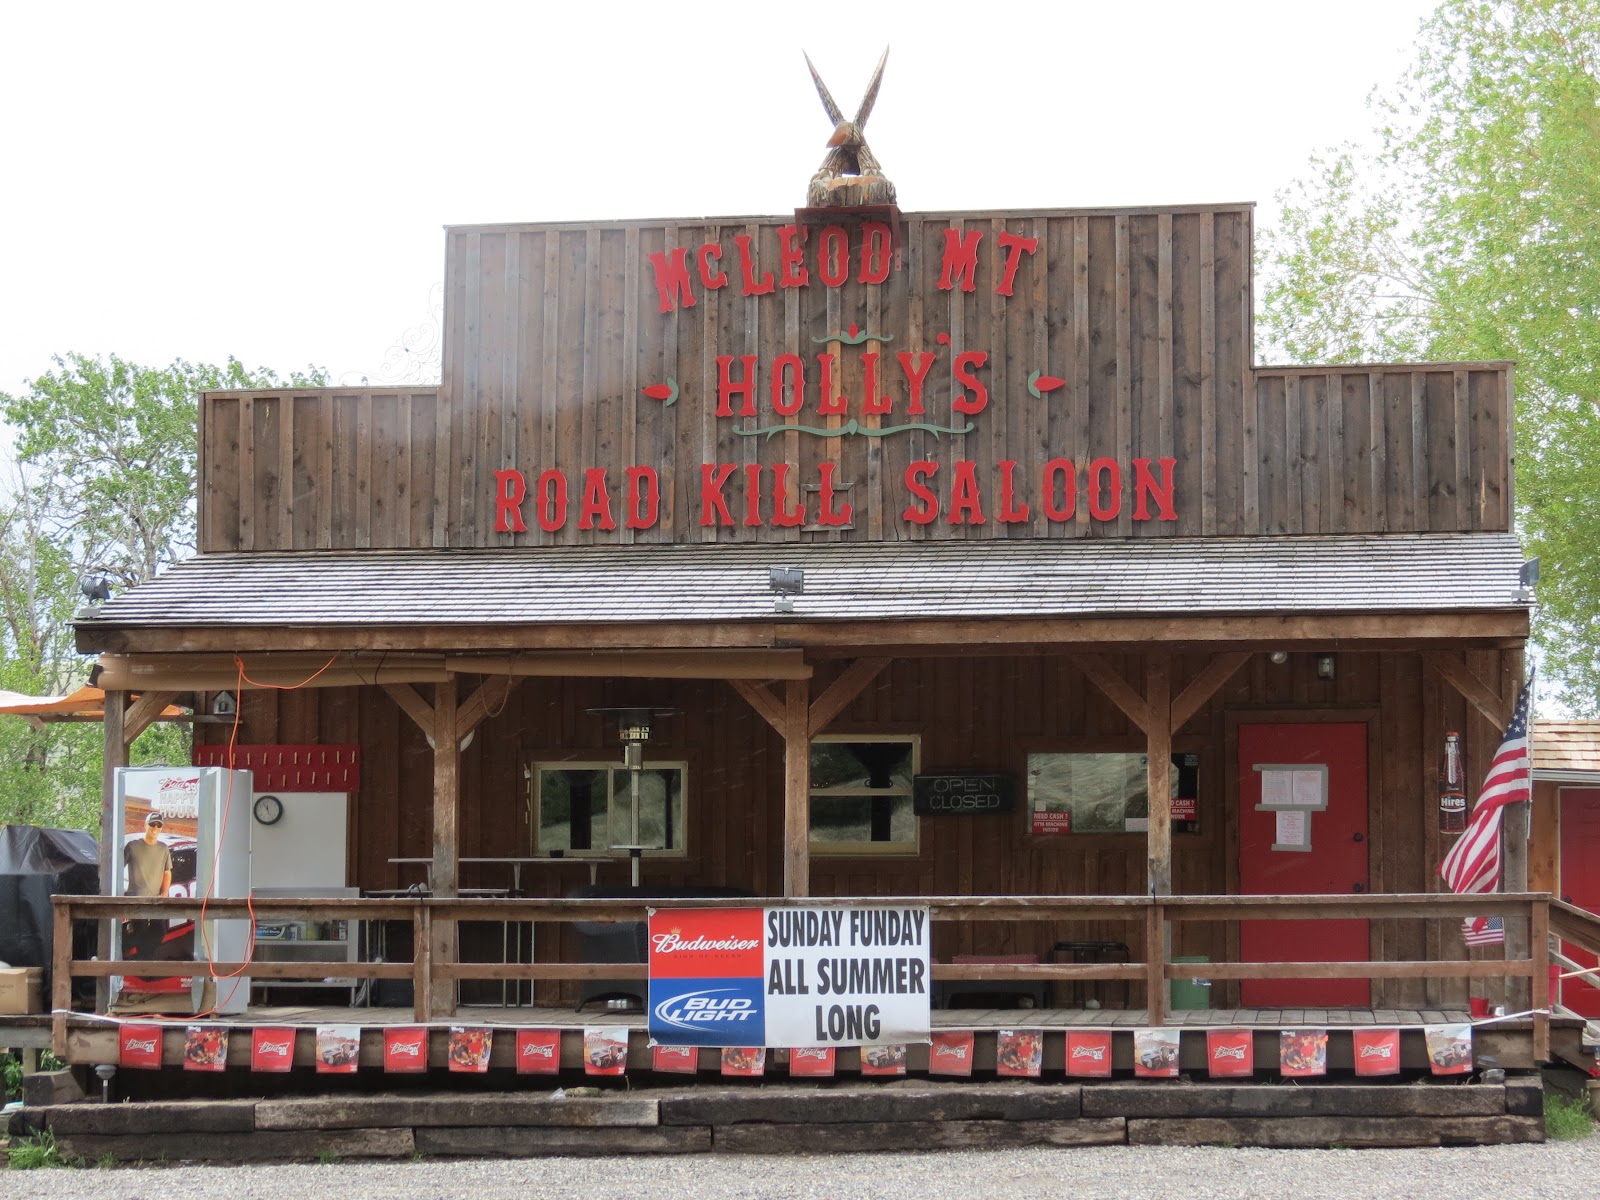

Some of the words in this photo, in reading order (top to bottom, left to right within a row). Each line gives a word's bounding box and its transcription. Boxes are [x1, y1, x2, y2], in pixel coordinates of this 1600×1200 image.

[937, 228, 1038, 297] MT
[716, 332, 989, 418] HOLLY'S
[494, 465, 661, 533] ROAD
[700, 461, 853, 528] KILL
[903, 457, 1179, 527] SALOON
[934, 778, 995, 792] OPEN
[929, 795, 1000, 809] CLOSED
[1441, 796, 1466, 807] Hires
[1033, 812, 1048, 820] NEED
[767, 910, 844, 947] SUNDAY
[850, 909, 925, 947] FUNDAY
[652, 933, 760, 953] Budweiser
[768, 958, 809, 995] ALL
[817, 957, 926, 995] SUMMER
[684, 998, 752, 1010] BUD
[669, 1010, 758, 1022] LIGHT
[815, 1004, 881, 1041] LONG
